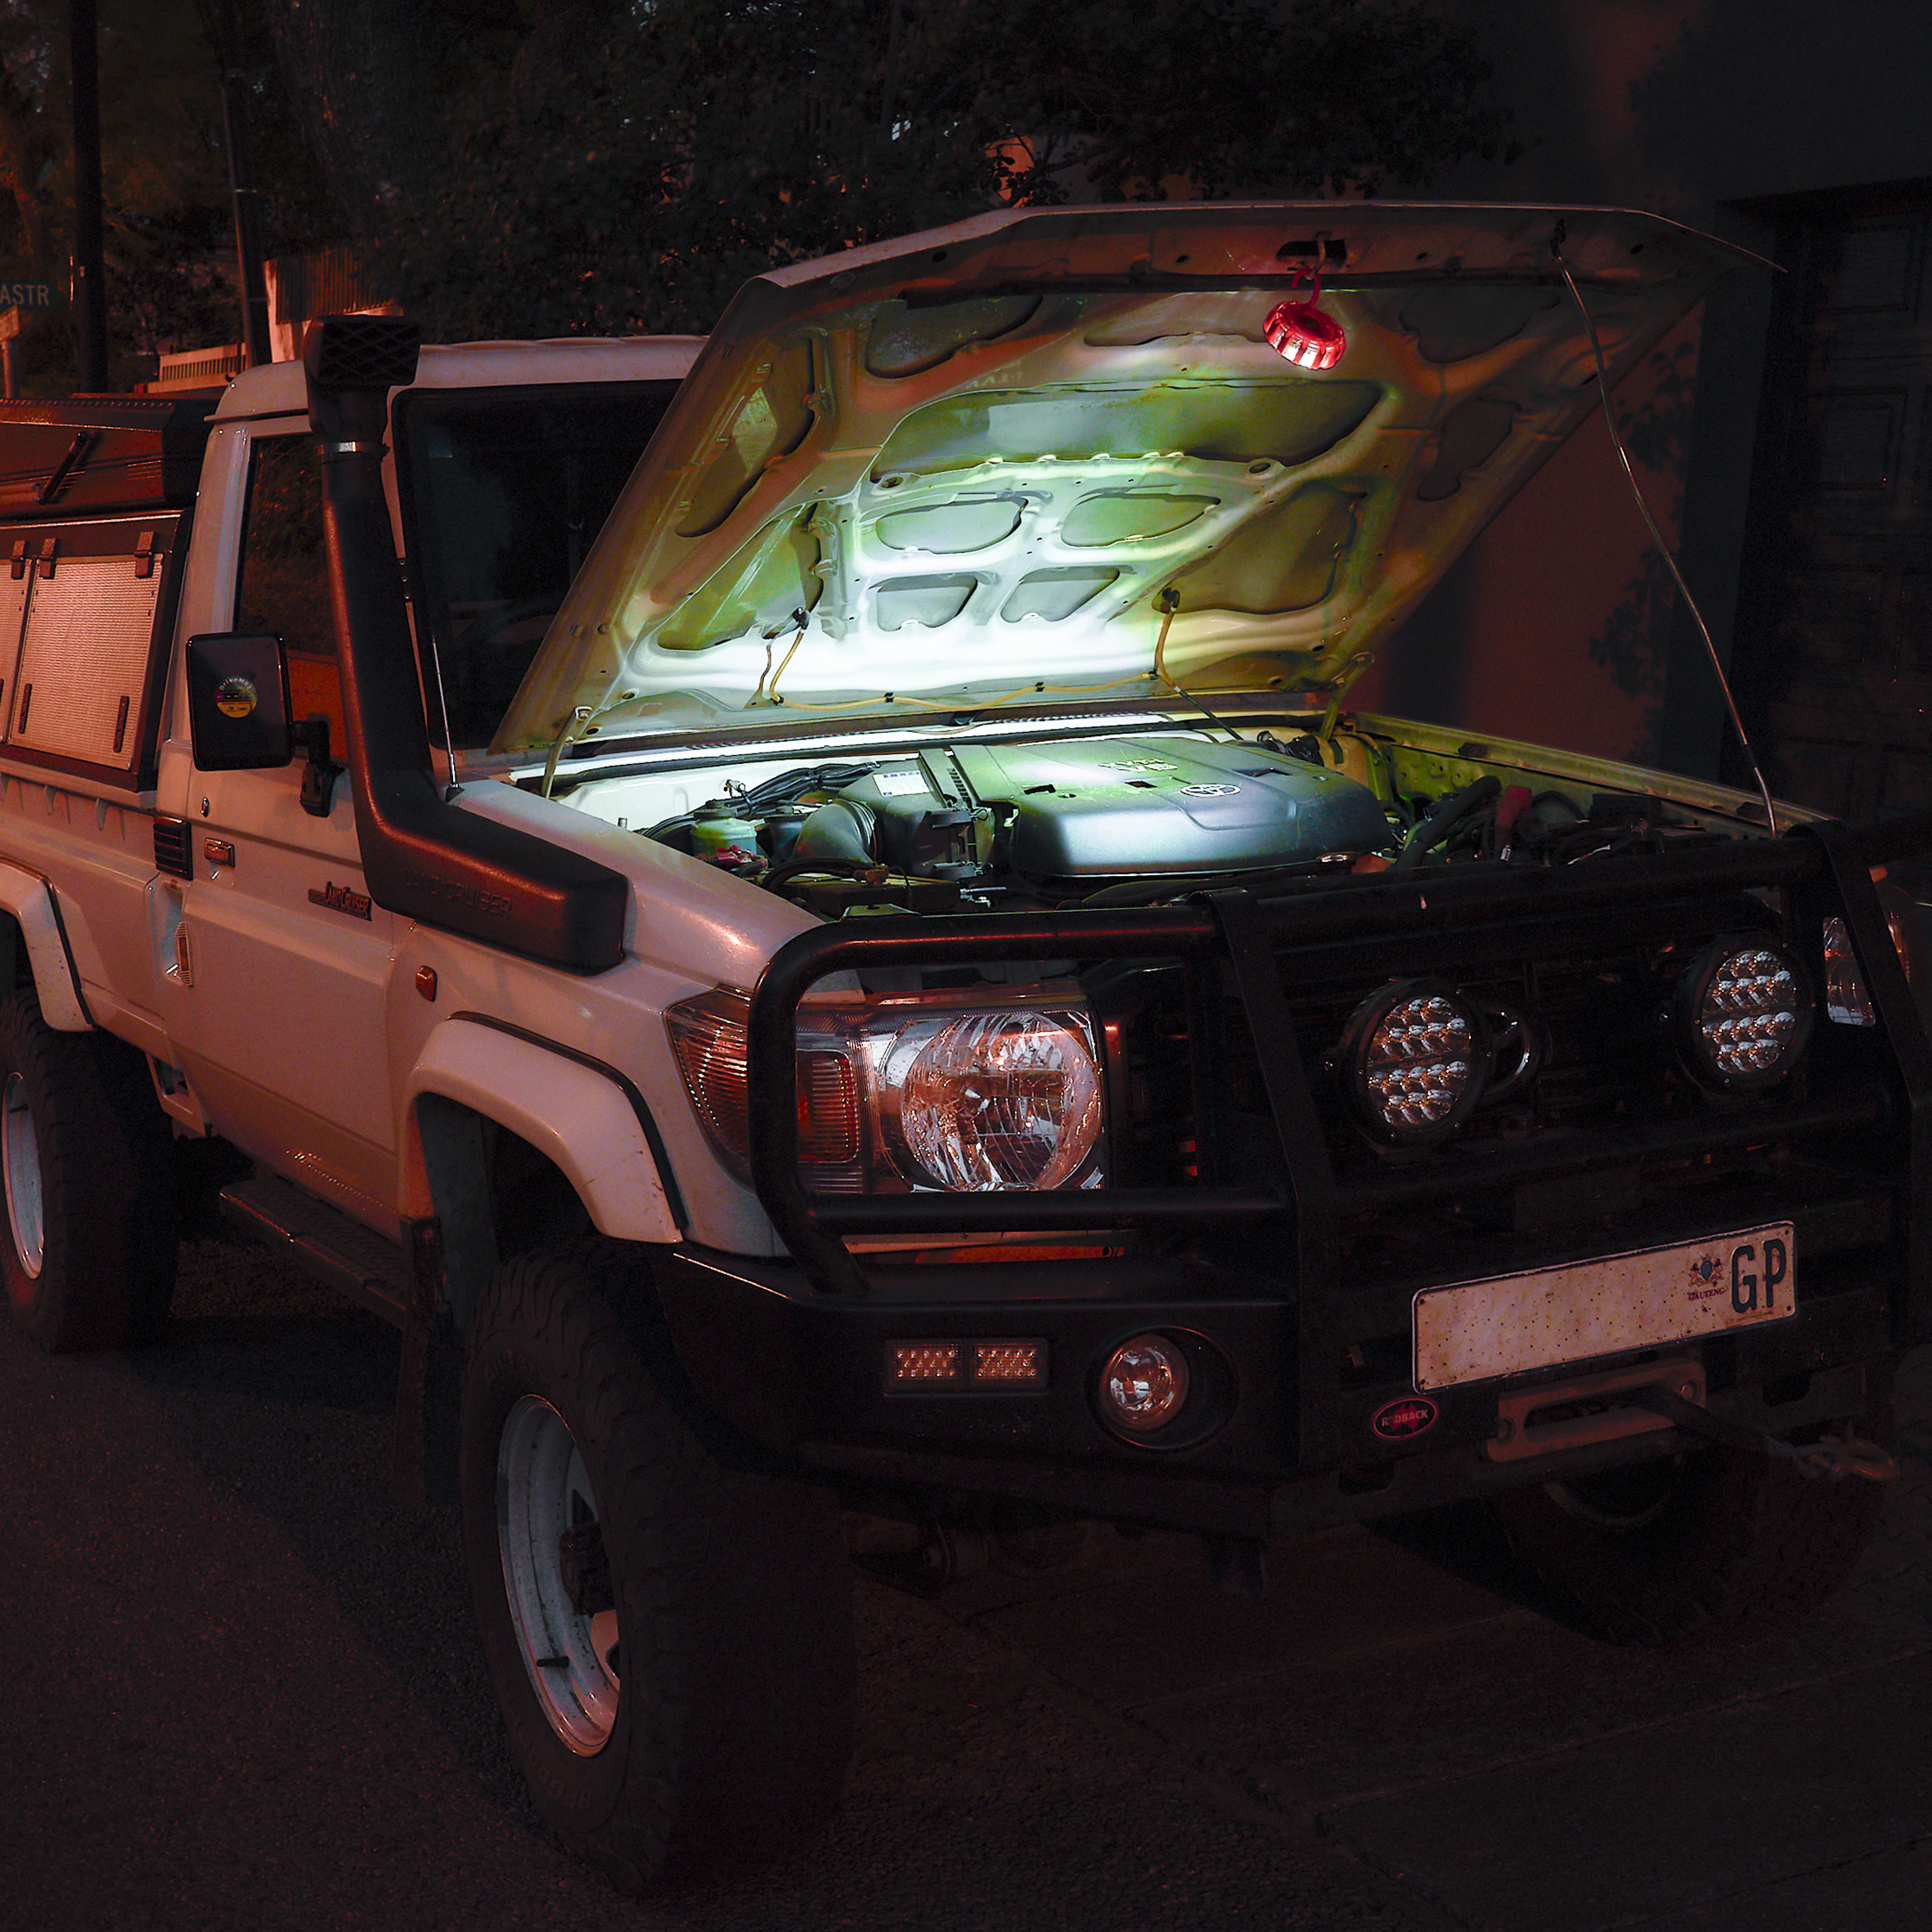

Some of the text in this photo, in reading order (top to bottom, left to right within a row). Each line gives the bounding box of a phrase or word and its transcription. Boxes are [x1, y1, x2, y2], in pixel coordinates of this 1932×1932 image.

[1687, 1238, 1786, 1314] GAUTENG GP
[1382, 1409, 1429, 1427] RDBACK
